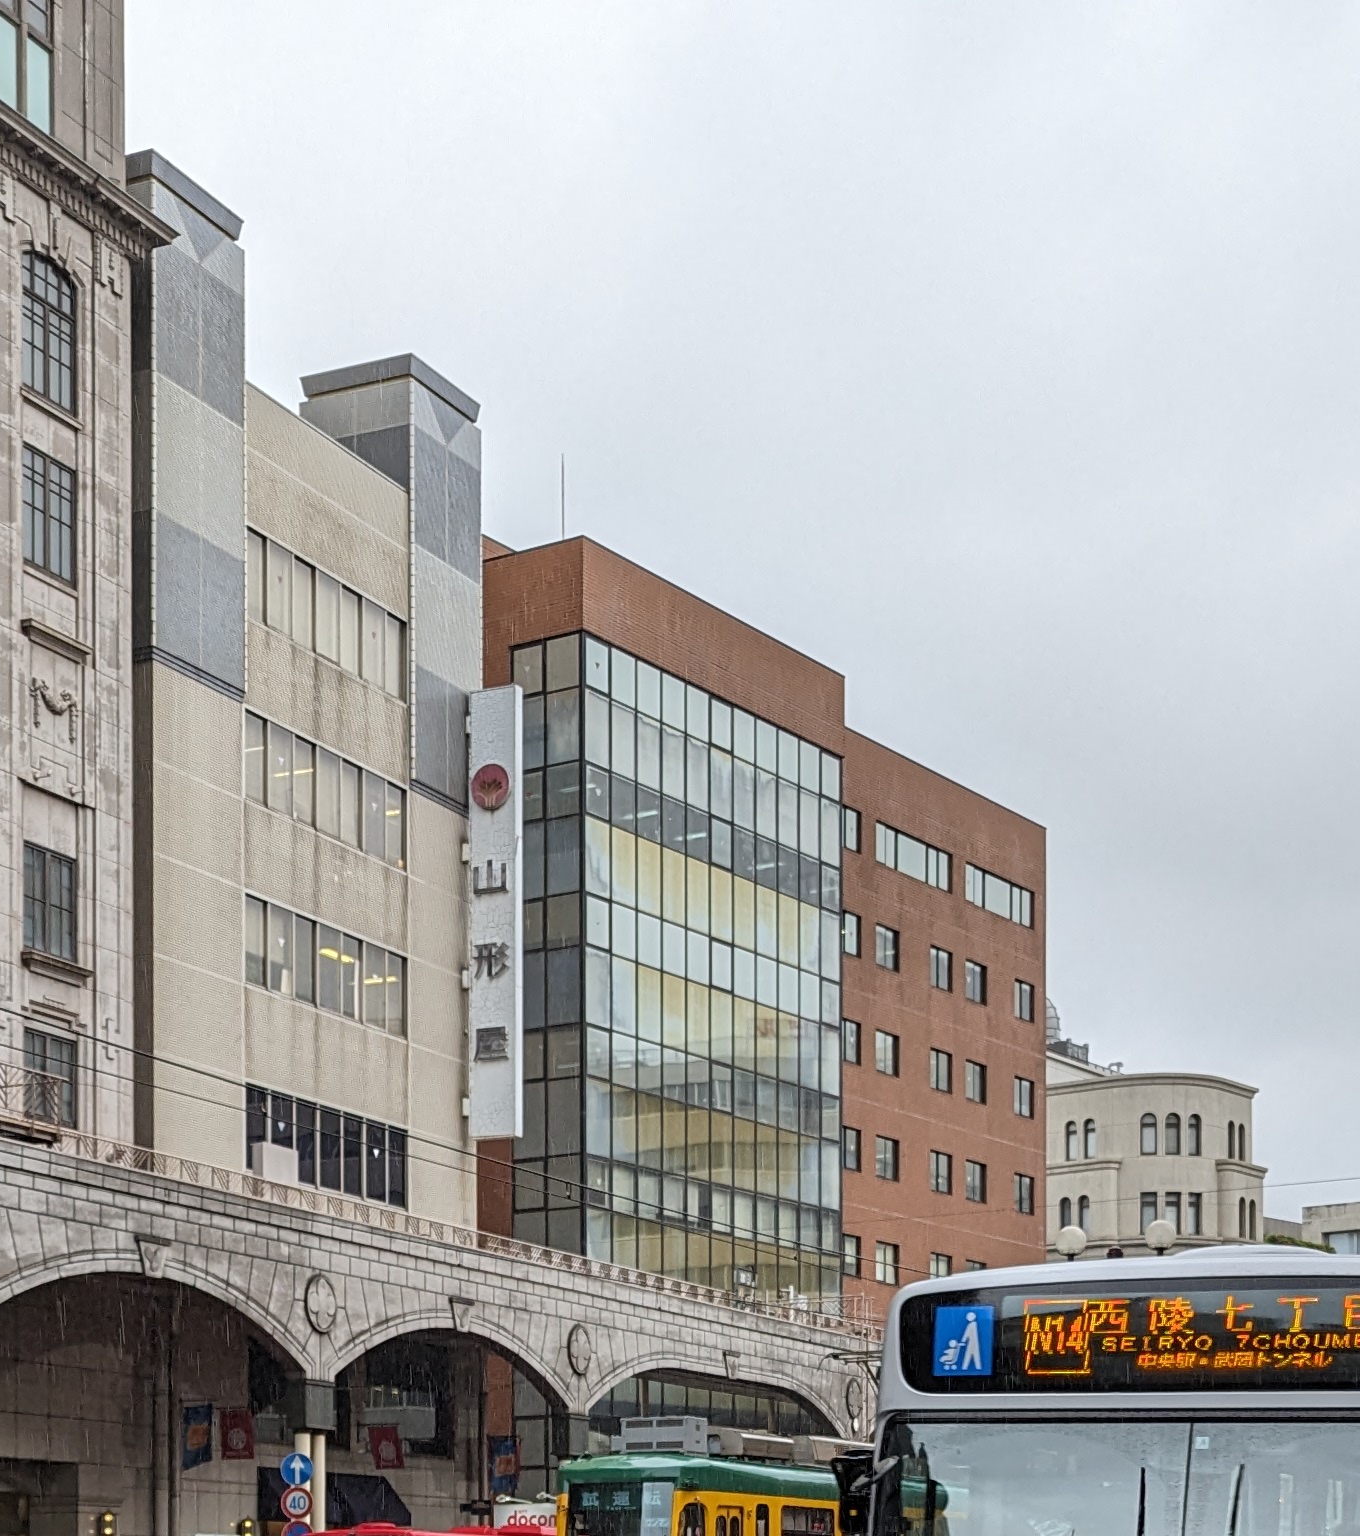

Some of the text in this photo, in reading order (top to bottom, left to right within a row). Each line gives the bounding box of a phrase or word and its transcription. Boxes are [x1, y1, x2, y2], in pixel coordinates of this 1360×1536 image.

[473, 859, 510, 1063] 山形屋
[1100, 1334, 1213, 1352] SEIRYO
[288, 1495, 307, 1511] 40
[580, 1490, 662, 1507] 試運転
